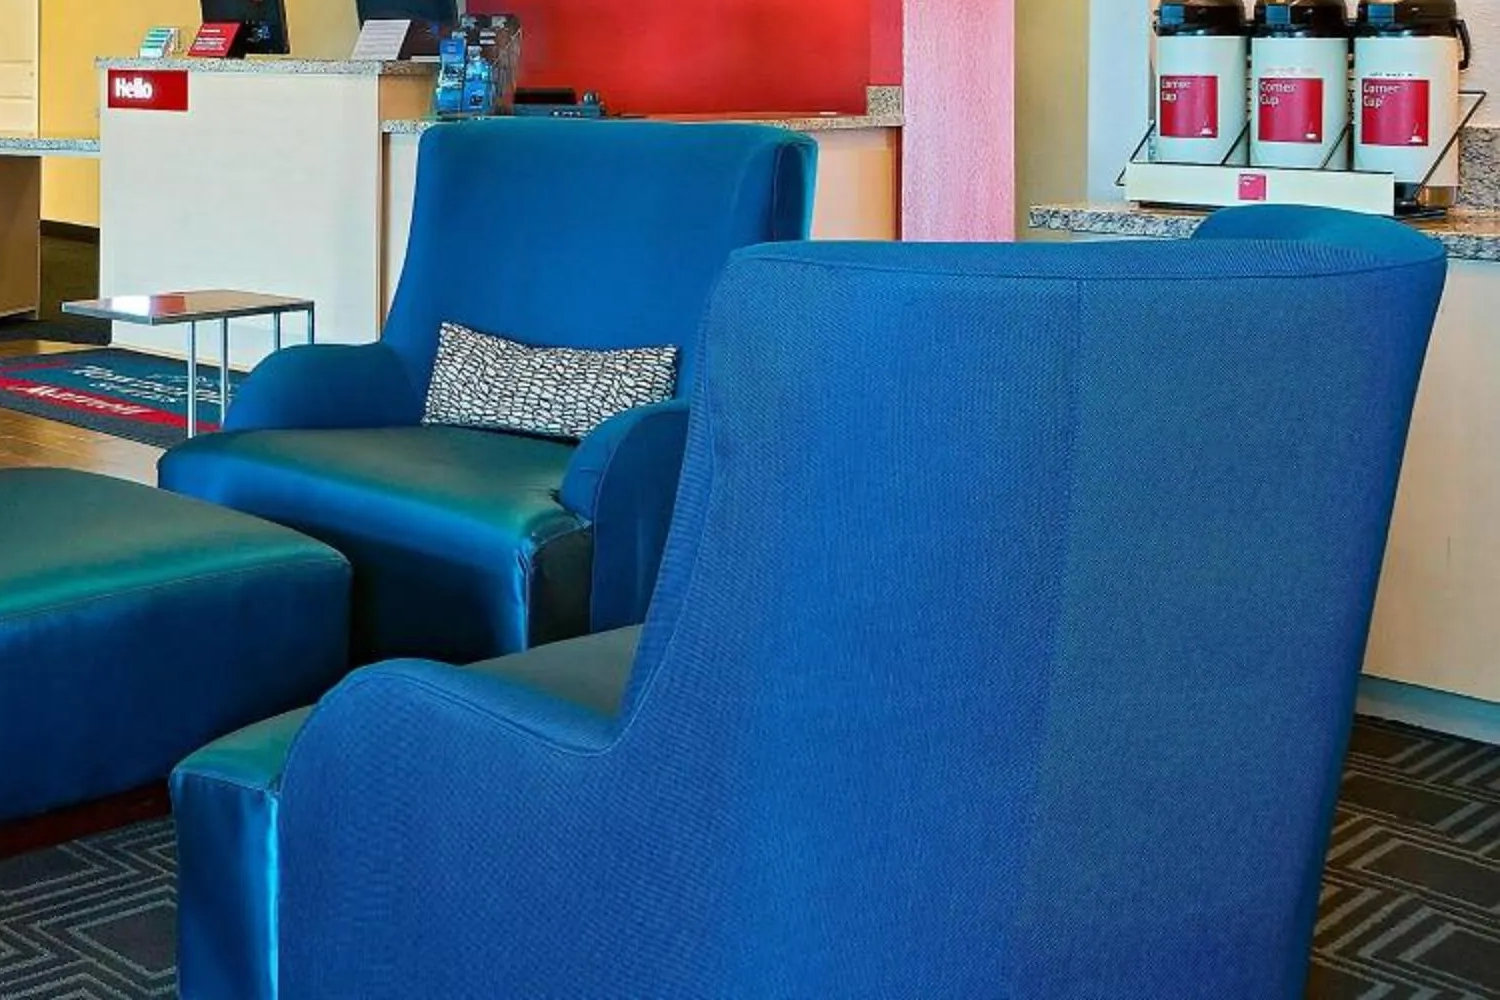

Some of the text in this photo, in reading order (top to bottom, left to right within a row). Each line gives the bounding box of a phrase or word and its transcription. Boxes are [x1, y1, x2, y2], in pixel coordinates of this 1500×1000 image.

[115, 77, 153, 99] Hello
[1260, 81, 1297, 94] Corner
[1363, 82, 1400, 94] Corner
[1160, 90, 1178, 103] Cup
[1260, 94, 1280, 107] Cup
